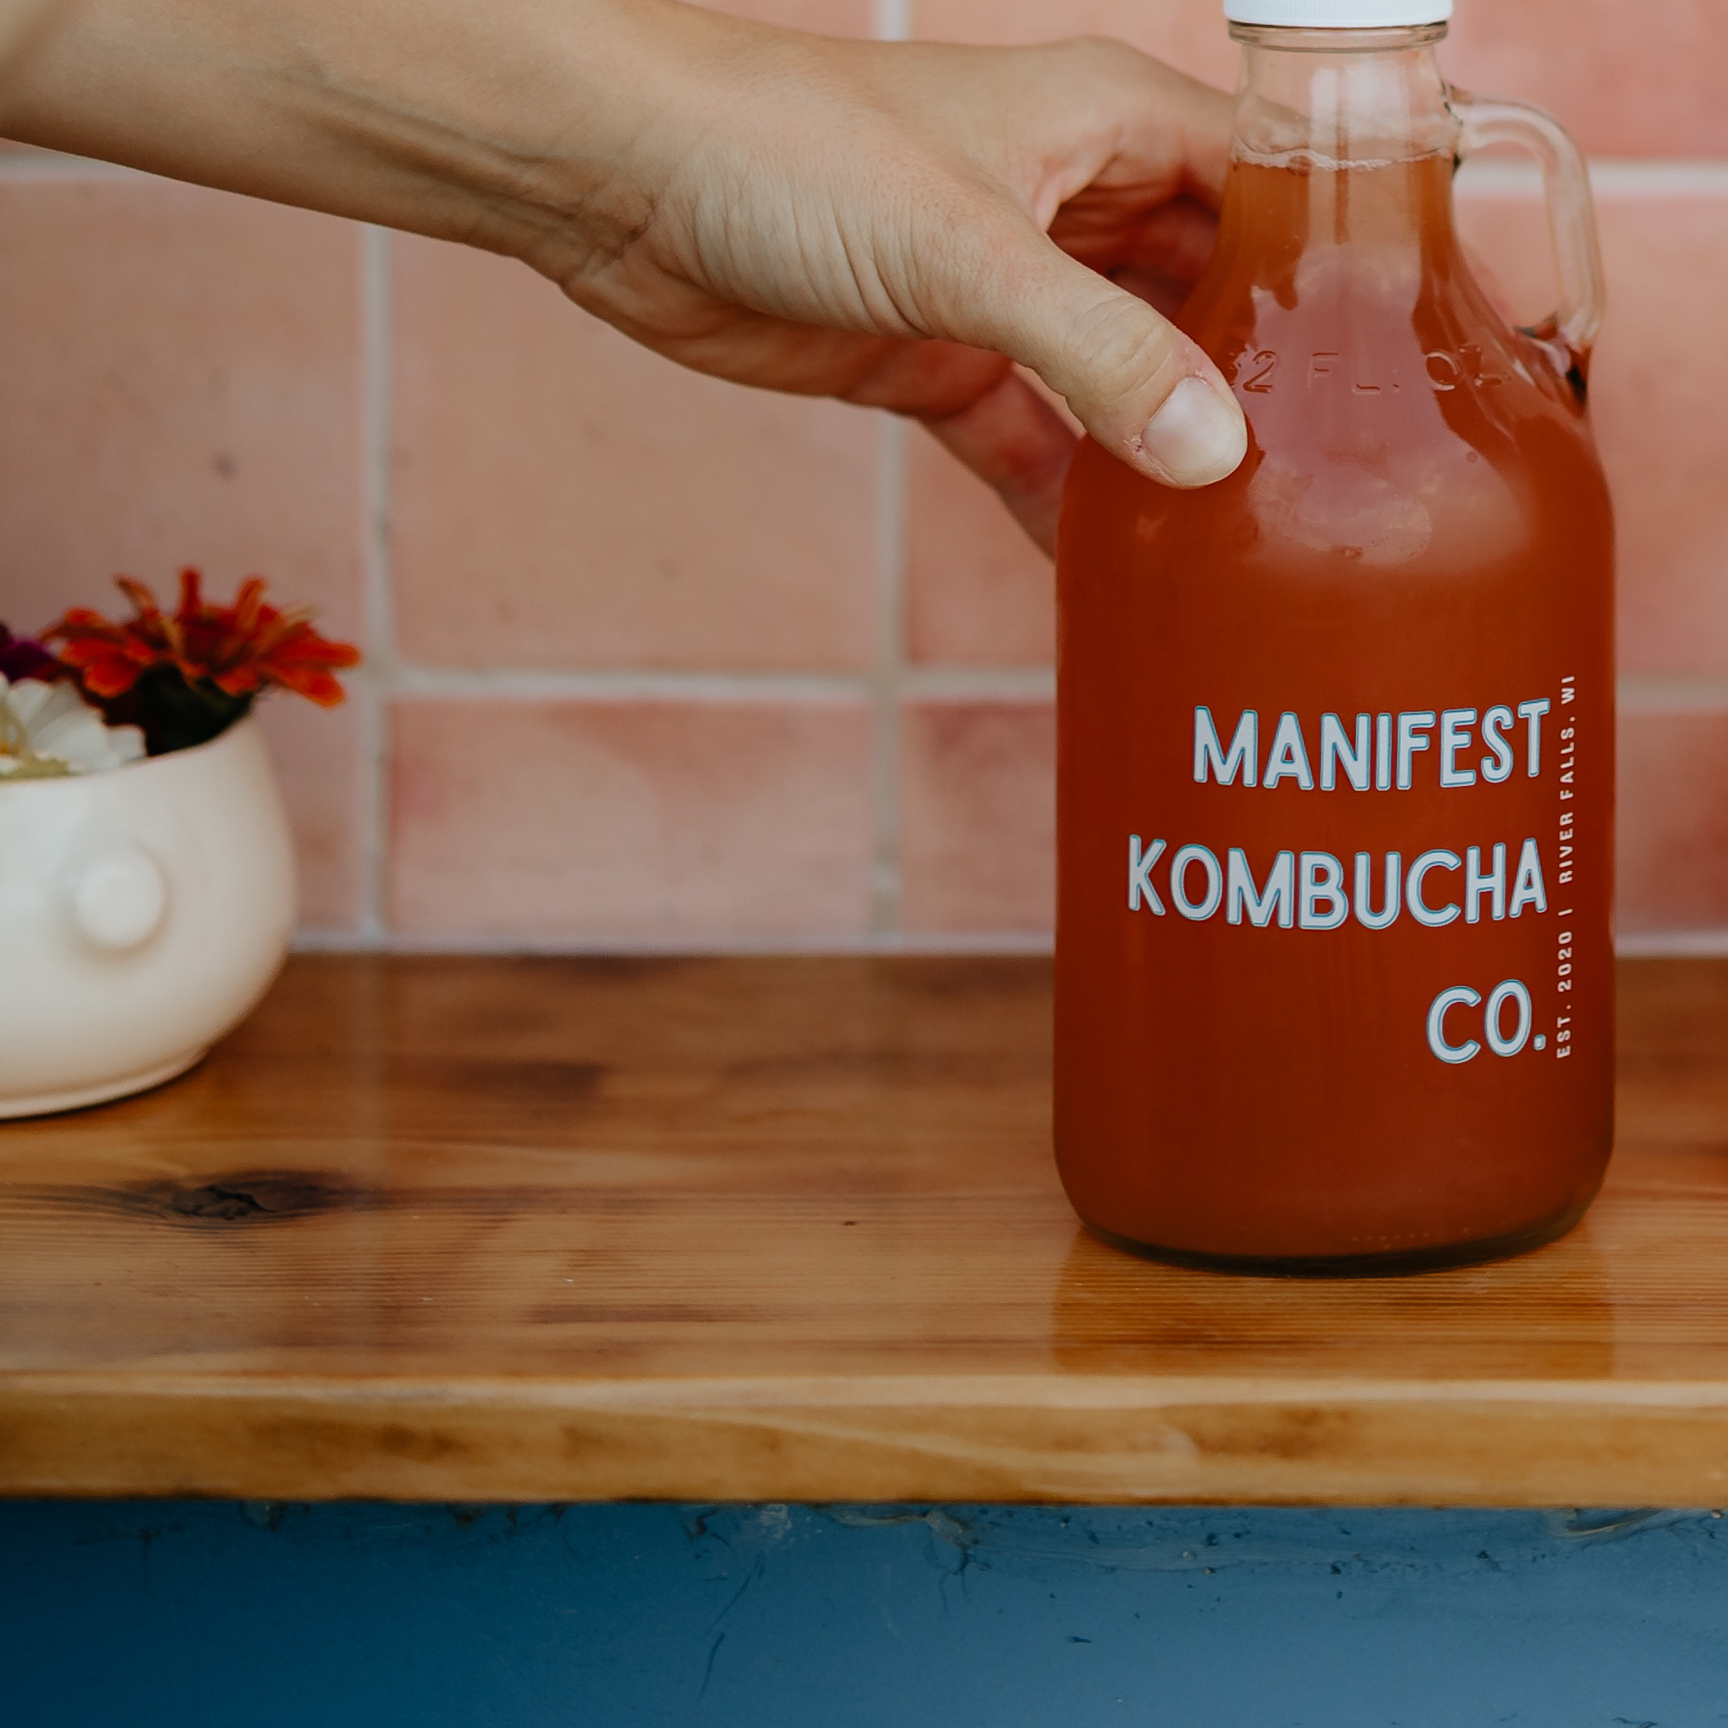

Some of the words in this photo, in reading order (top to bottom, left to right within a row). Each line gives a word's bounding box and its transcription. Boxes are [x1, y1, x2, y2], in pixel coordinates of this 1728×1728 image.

[1561, 675, 1576, 705] WI
[1193, 698, 1550, 791] MANIFEST
[1127, 834, 1548, 930] KOMBUCHA
[1558, 811, 1574, 885] RIVER
[1557, 931, 1573, 993] 2020
[1426, 979, 1547, 1064] CO.
[1556, 1004, 1572, 1059] EST.
